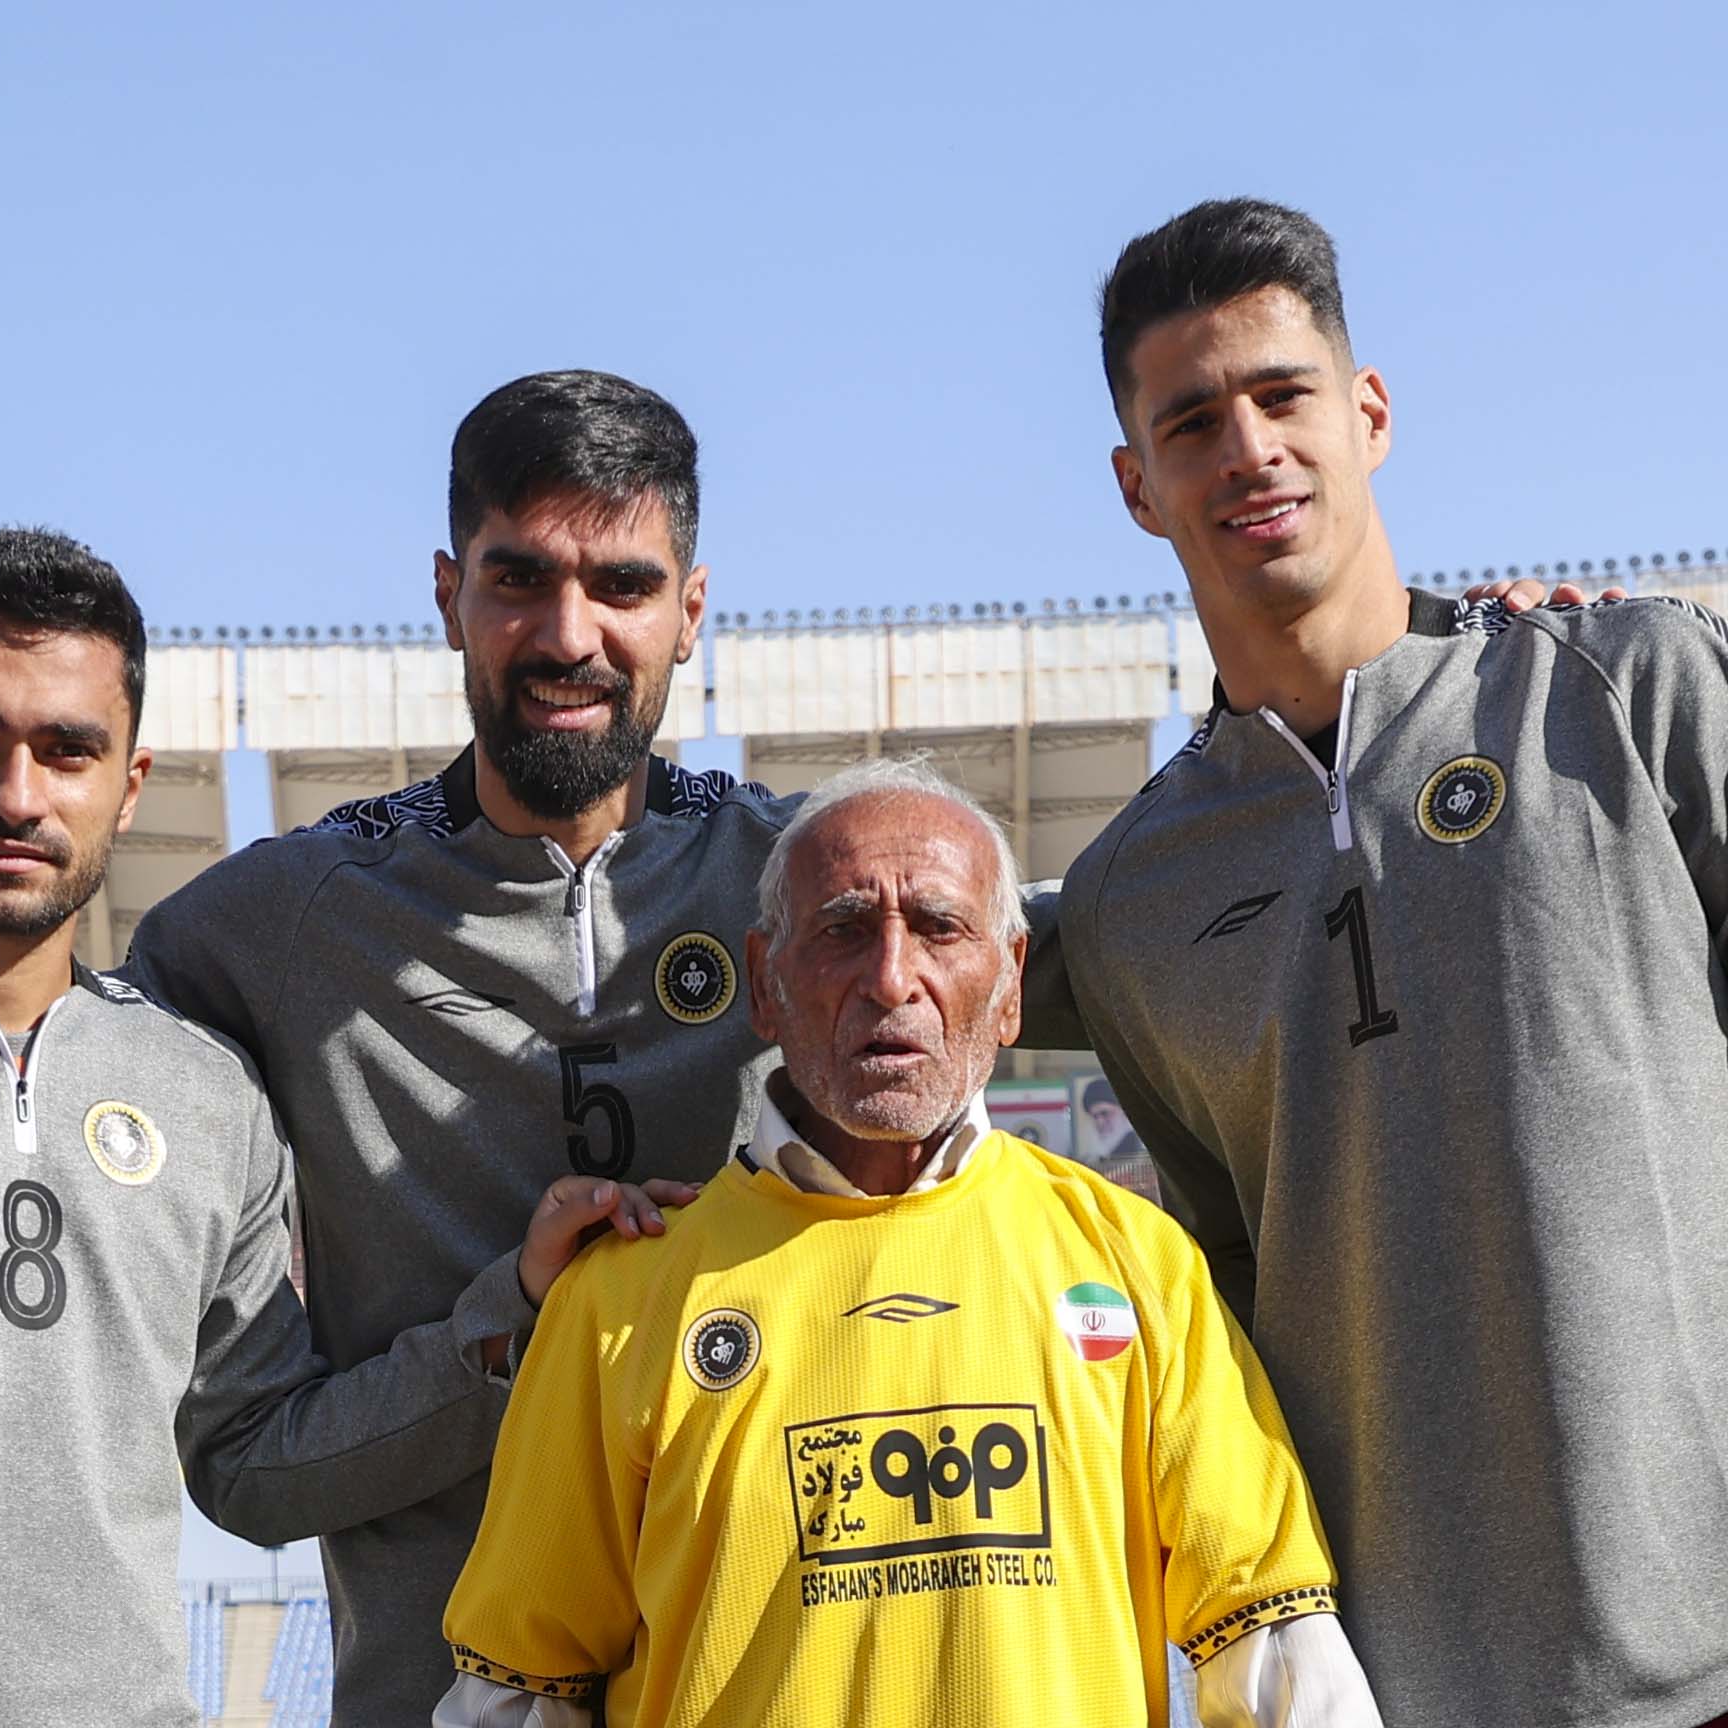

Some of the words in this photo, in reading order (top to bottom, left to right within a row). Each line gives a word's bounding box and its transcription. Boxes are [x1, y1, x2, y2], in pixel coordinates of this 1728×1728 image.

[1324, 886, 1399, 1048] 1
[559, 1042, 634, 1178] 5
[802, 1455, 864, 1503] فولاد
[886, 1553, 982, 1596] MOBARAKEH
[987, 1552, 1030, 1586] STEEL
[1034, 1554, 1057, 1587] CO.
